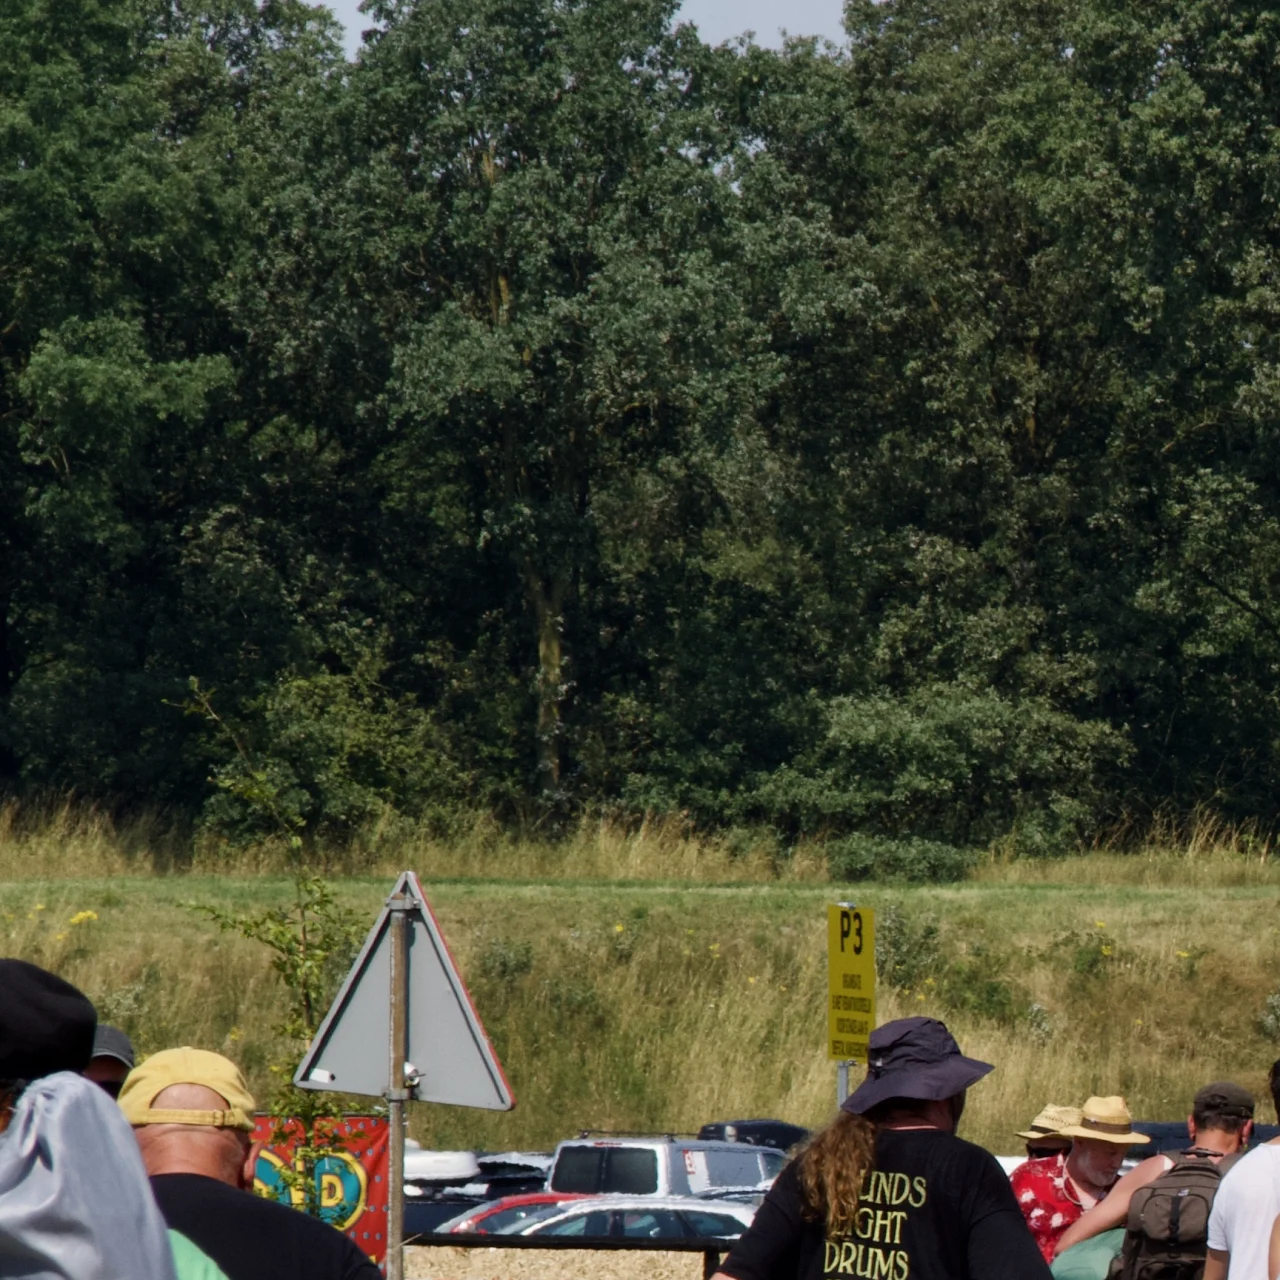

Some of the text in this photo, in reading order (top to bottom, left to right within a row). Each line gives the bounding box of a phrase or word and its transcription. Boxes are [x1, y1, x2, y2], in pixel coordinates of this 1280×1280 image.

[840, 910, 863, 955] P3
[860, 1170, 927, 1208] UNDS
[838, 1207, 908, 1244] GHT
